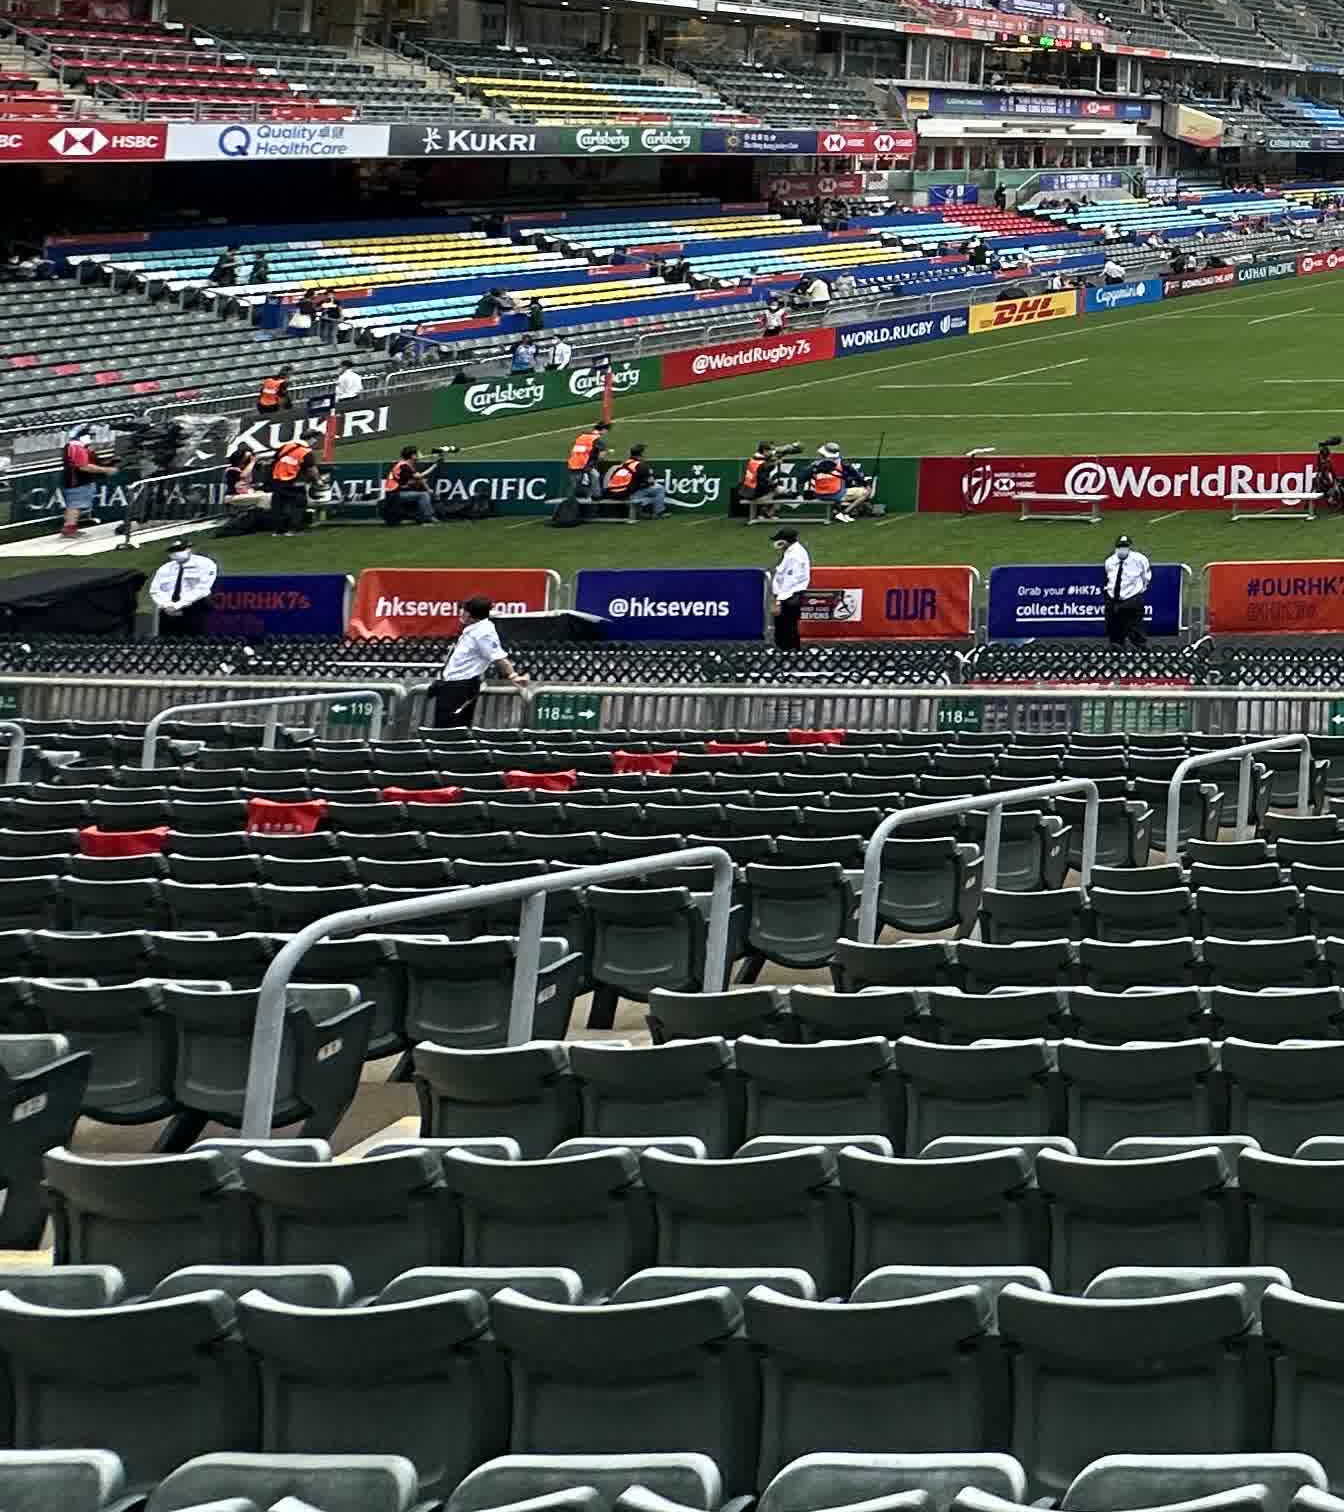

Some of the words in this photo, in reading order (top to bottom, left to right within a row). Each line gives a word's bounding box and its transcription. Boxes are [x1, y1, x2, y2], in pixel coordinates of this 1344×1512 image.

[112, 135, 158, 149] HSBC
[257, 125, 317, 141] Quality
[447, 129, 536, 152] KUKRI
[576, 127, 630, 151] Carlsberg
[641, 128, 691, 151] Carlsberg
[256, 141, 347, 156] HealthCare
[1238, 266, 1267, 281] CATHAY
[1268, 262, 1294, 276] PACIFIC
[992, 298, 1056, 326] DHL
[841, 320, 934, 348] WORLD.RUGBY
[464, 377, 545, 414] Carlsberg
[435, 478, 545, 502] PACIFIC
[1017, 585, 1042, 596] Grab
[1043, 587, 1065, 598] your
[1067, 585, 1101, 595] #HK7s
[608, 597, 730, 618] @hksevens
[886, 589, 937, 620] OUR
[351, 703, 373, 715] 119
[536, 706, 560, 720] 118
[939, 710, 963, 724] 118
